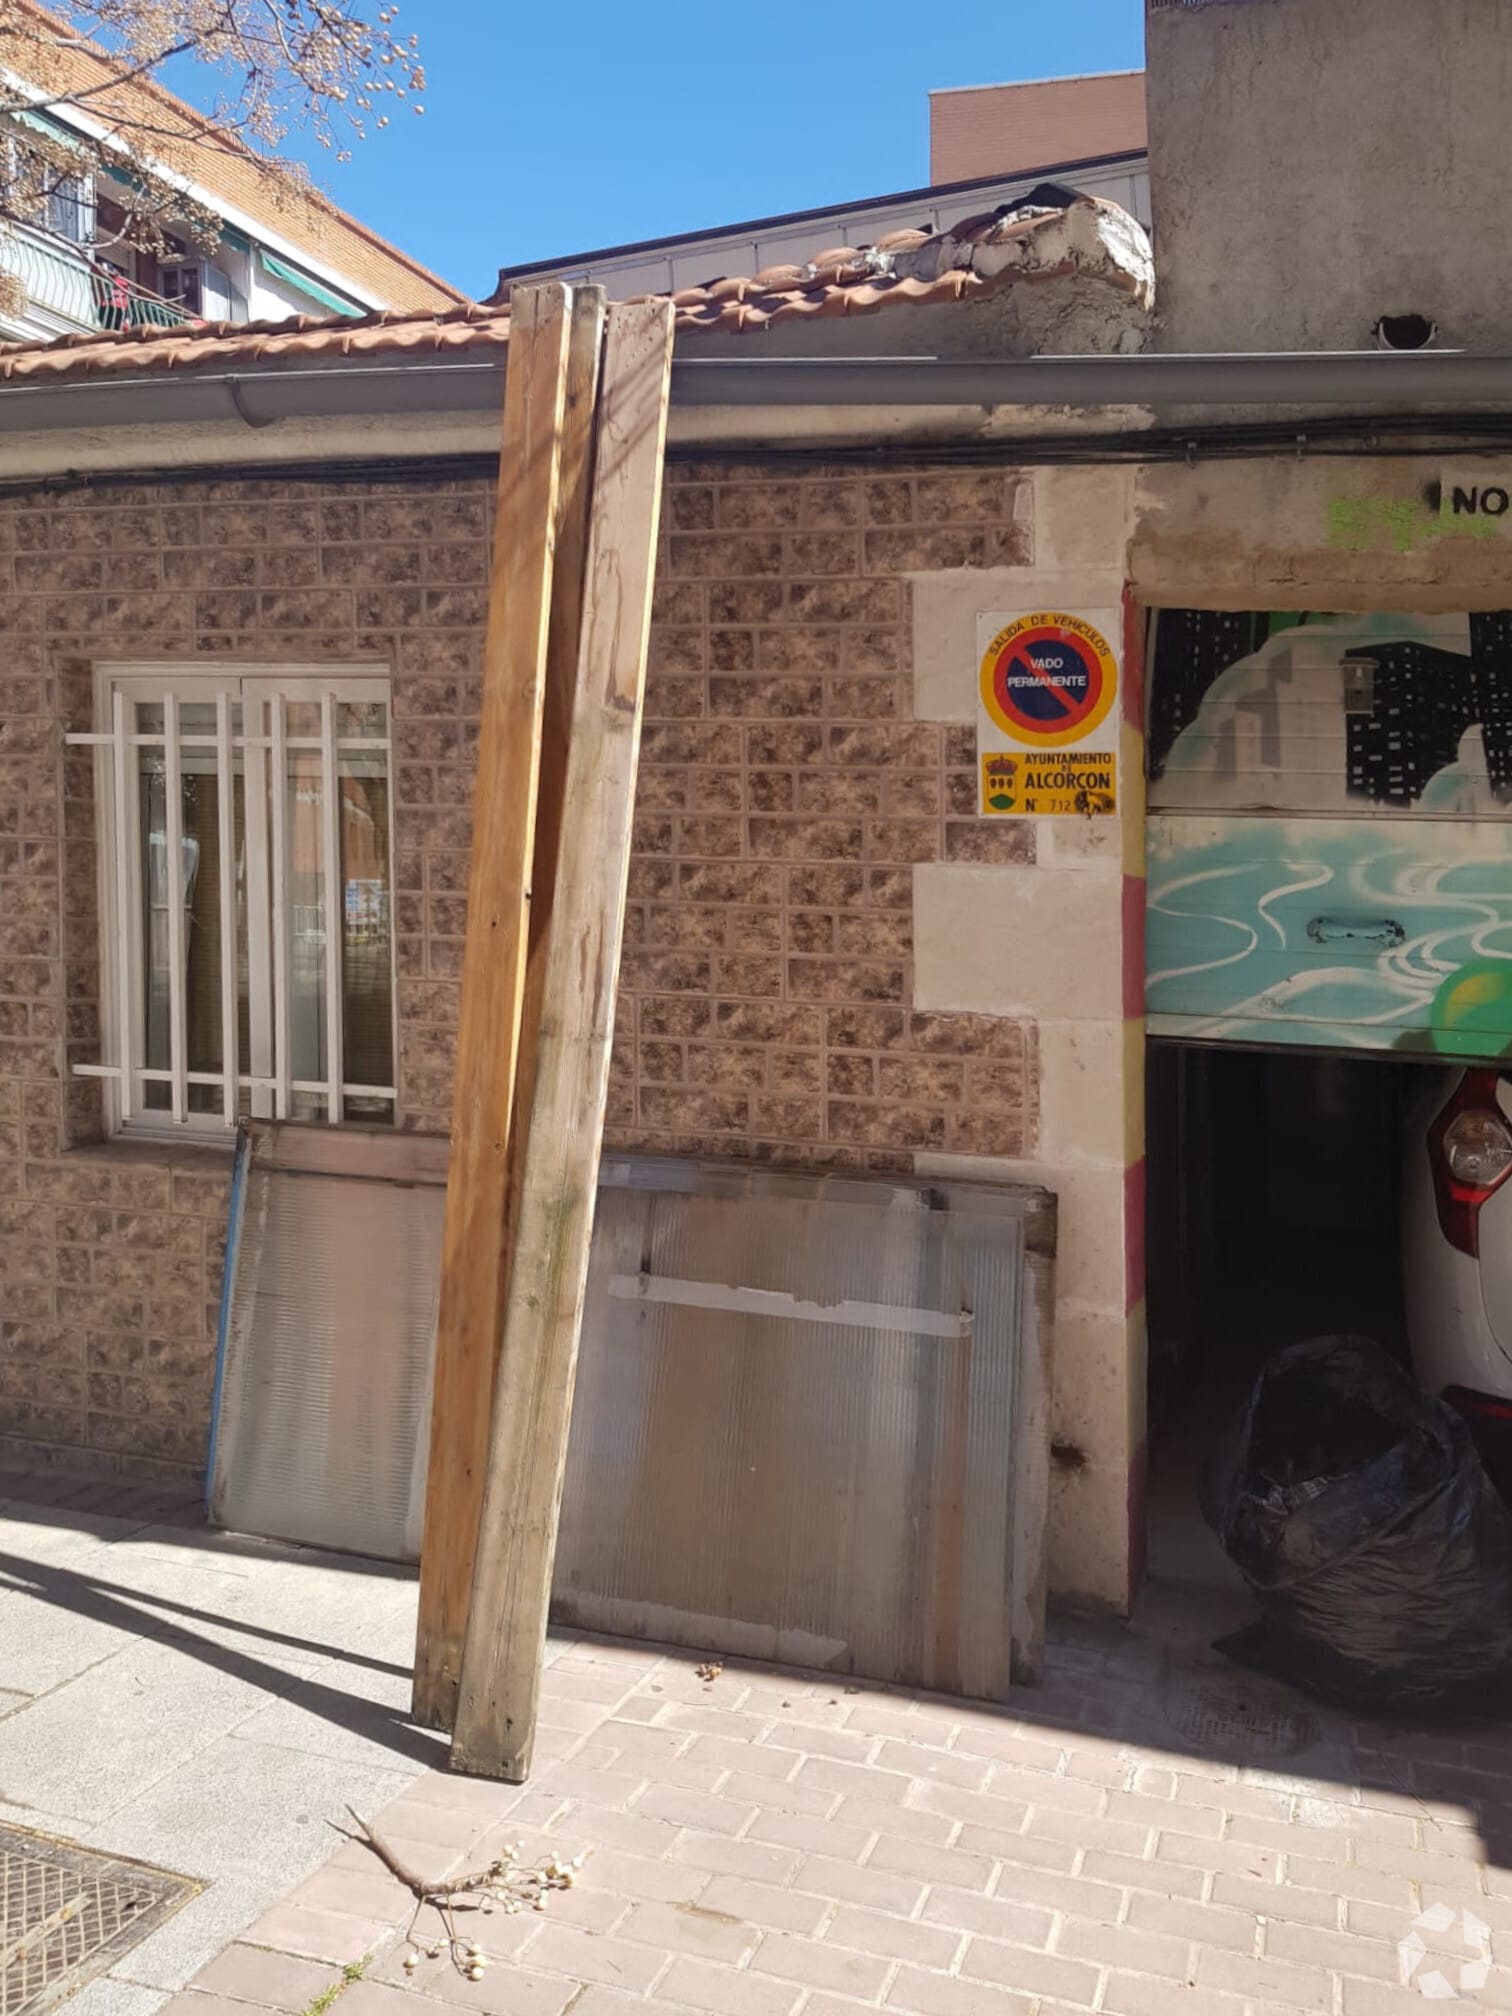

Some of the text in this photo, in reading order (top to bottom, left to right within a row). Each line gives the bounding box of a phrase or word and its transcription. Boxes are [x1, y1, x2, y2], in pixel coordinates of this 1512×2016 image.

[1453, 486, 1509, 515] NO
[990, 615, 1110, 656] SALIDA DE VEHICULOS
[1030, 657, 1064, 669] VADO
[1007, 675, 1087, 688] PERMANENTE
[1025, 752, 1111, 764] AYUNTAMIENTO
[1025, 772, 1110, 789] ALCORCON
